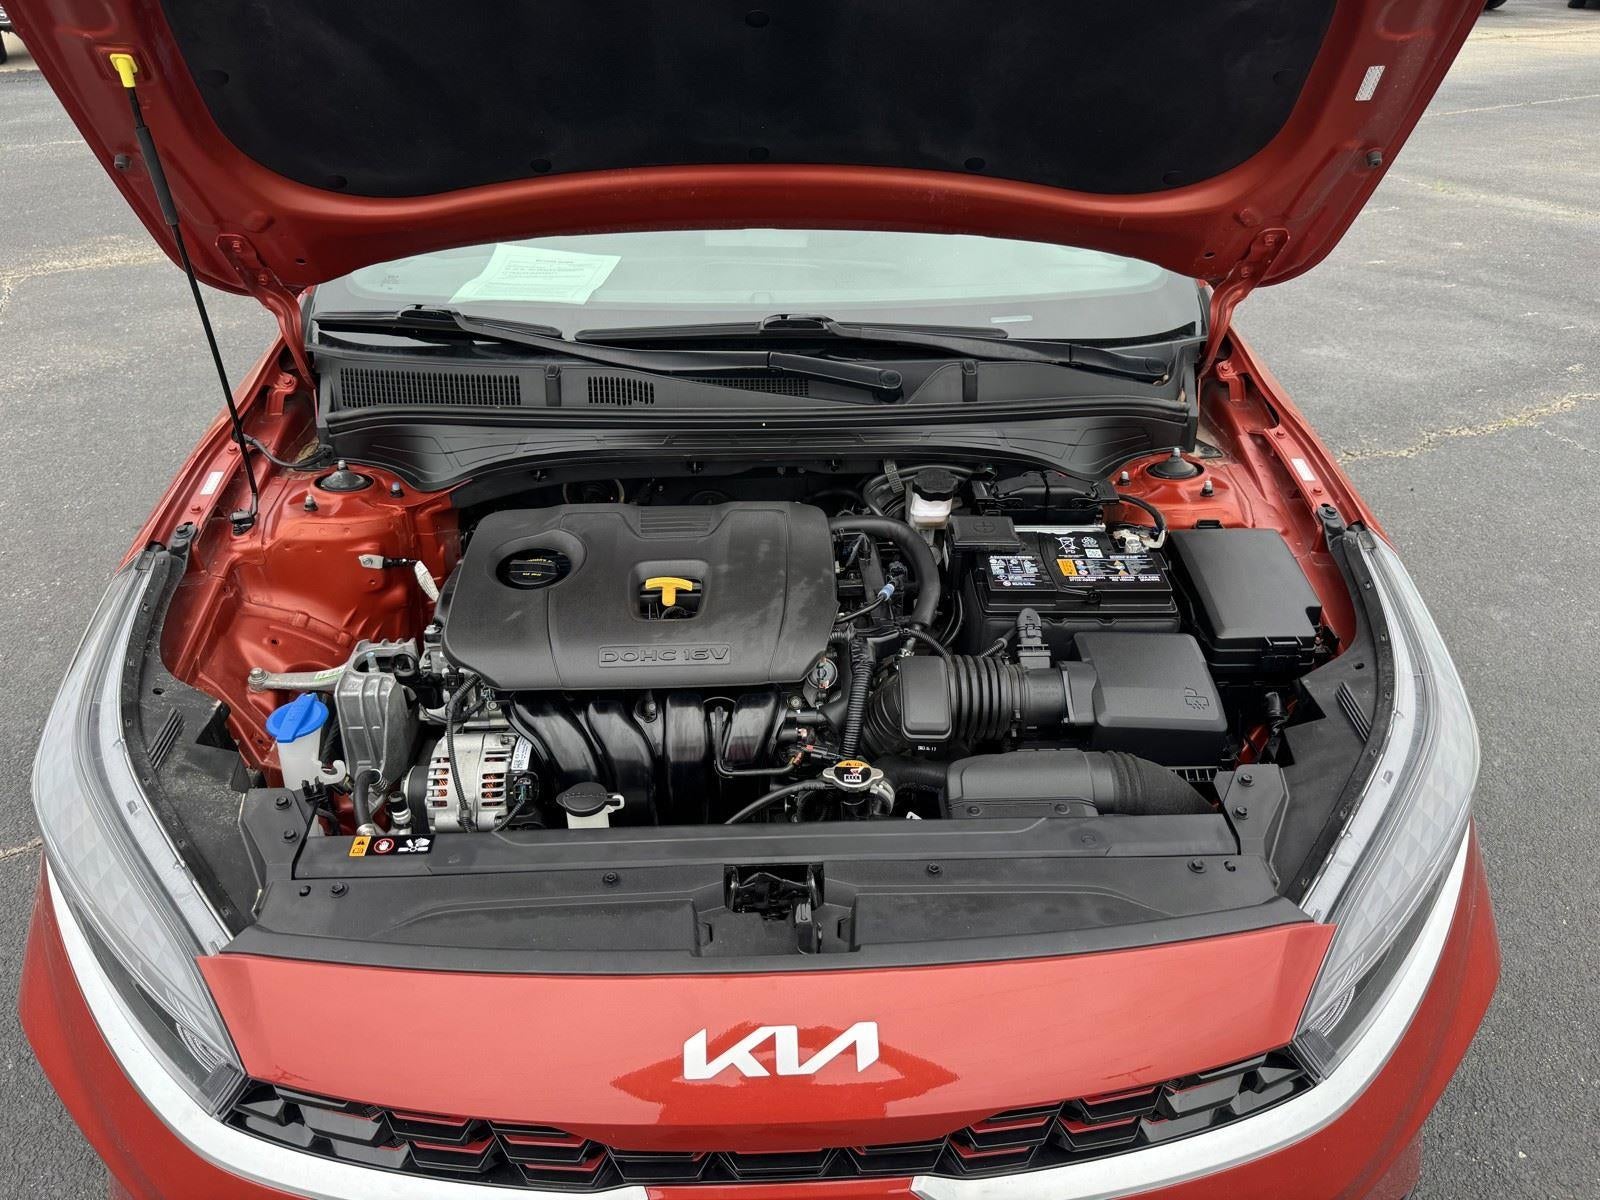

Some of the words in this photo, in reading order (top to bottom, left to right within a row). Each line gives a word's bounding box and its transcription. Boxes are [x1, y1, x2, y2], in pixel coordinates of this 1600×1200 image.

[600, 650, 677, 662] DOHC
[684, 647, 729, 661] 16V
[683, 1021, 880, 1080] KIA
